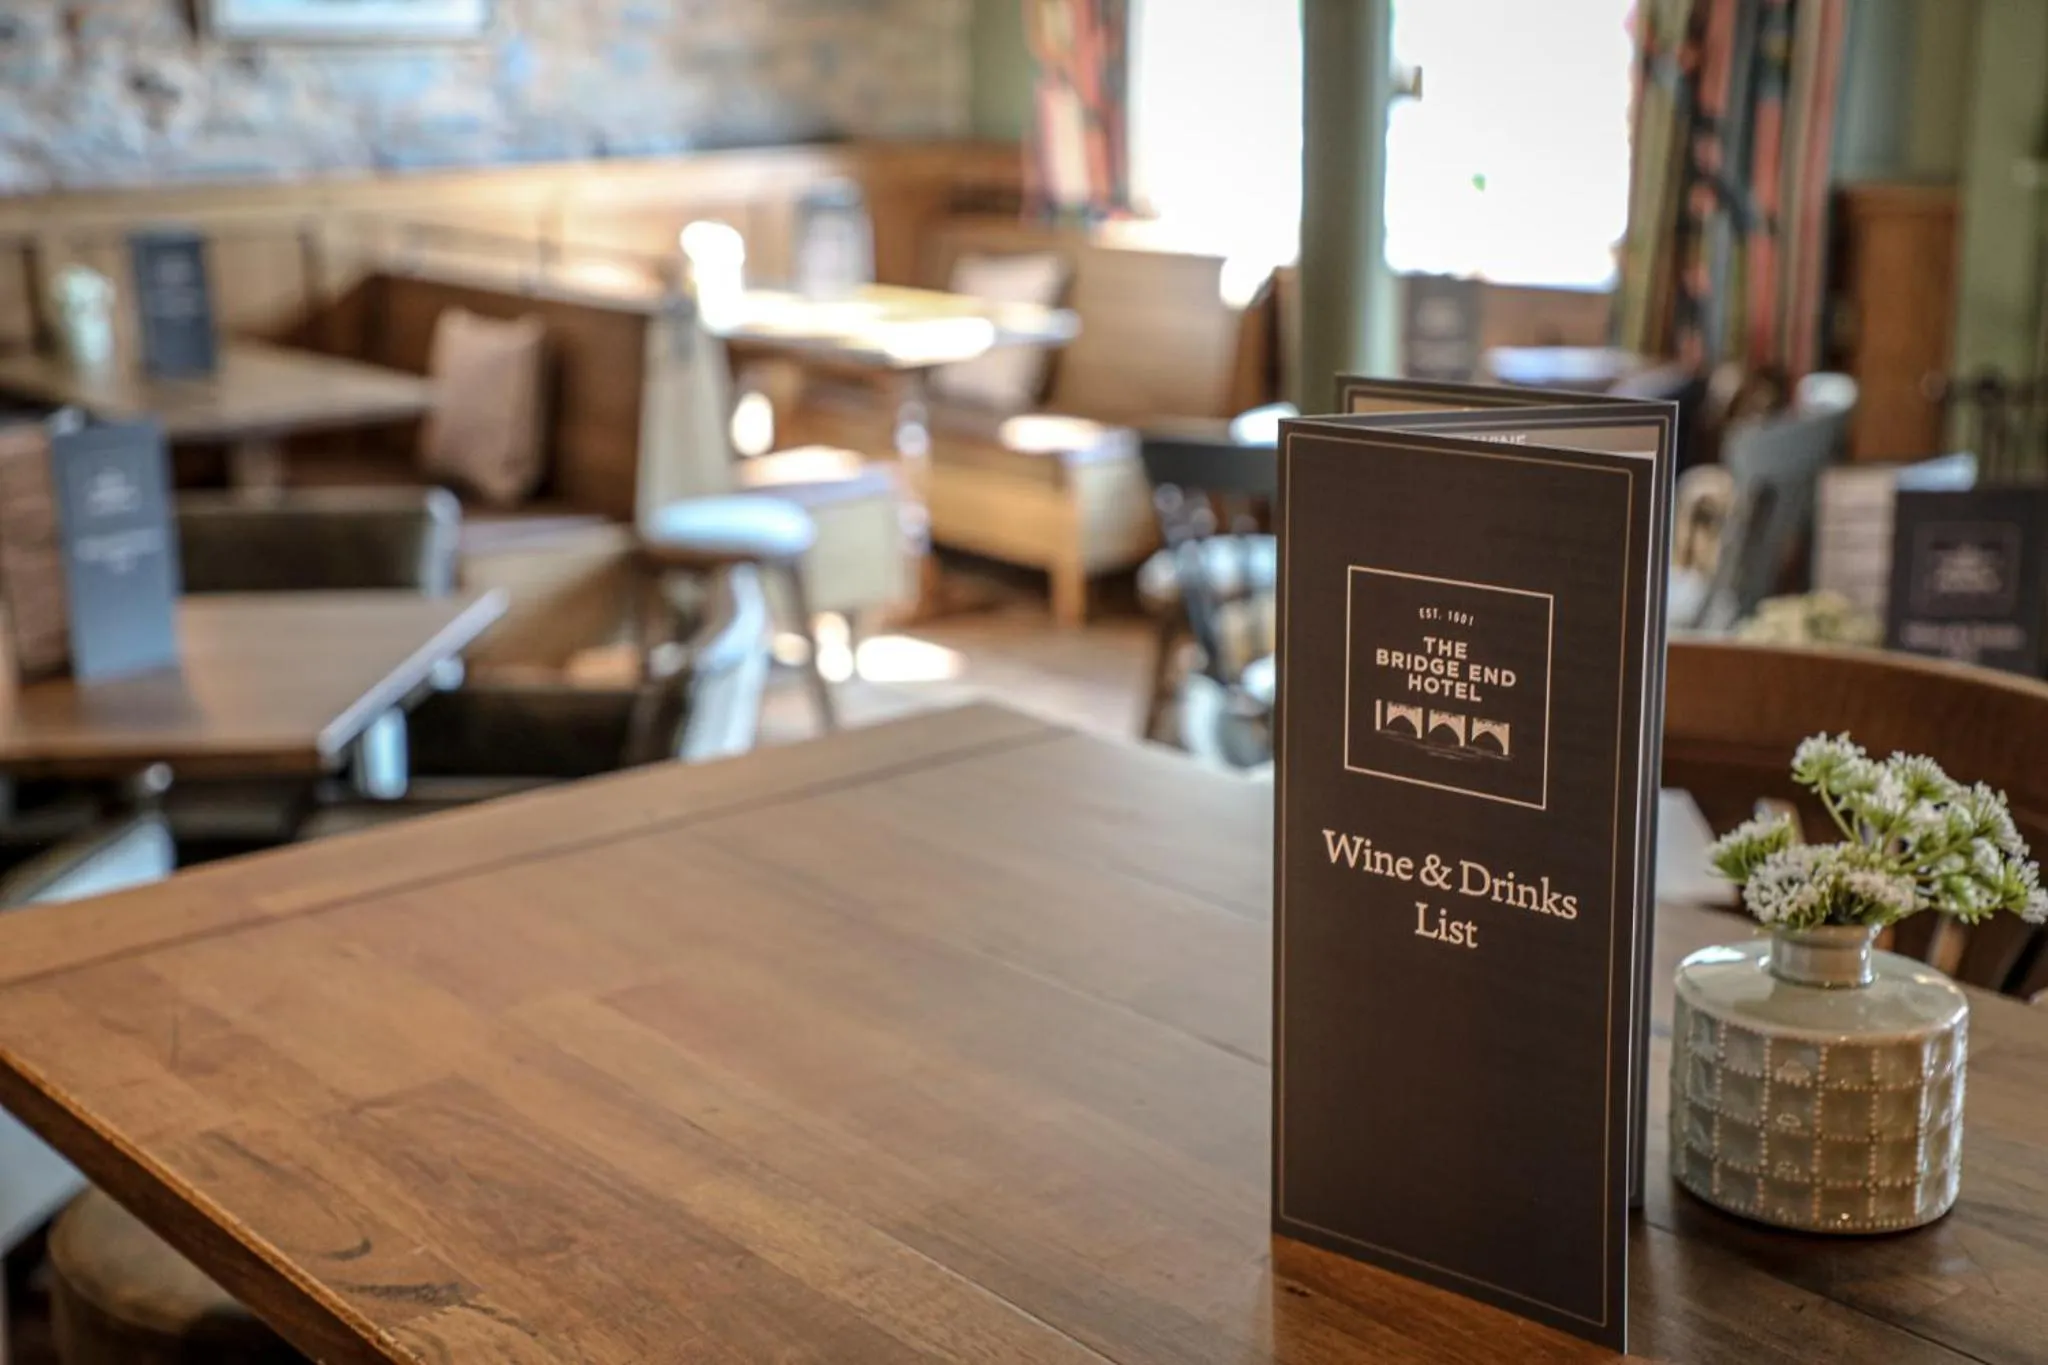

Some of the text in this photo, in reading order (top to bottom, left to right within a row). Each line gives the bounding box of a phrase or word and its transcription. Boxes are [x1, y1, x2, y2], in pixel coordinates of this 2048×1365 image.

[1376, 648, 1516, 687] BRIDGE END
[1423, 636, 1468, 660] THE
[1408, 674, 1482, 702] HOTEL
[1322, 829, 1578, 919] Wine & Drinks
[1415, 902, 1478, 948] List
